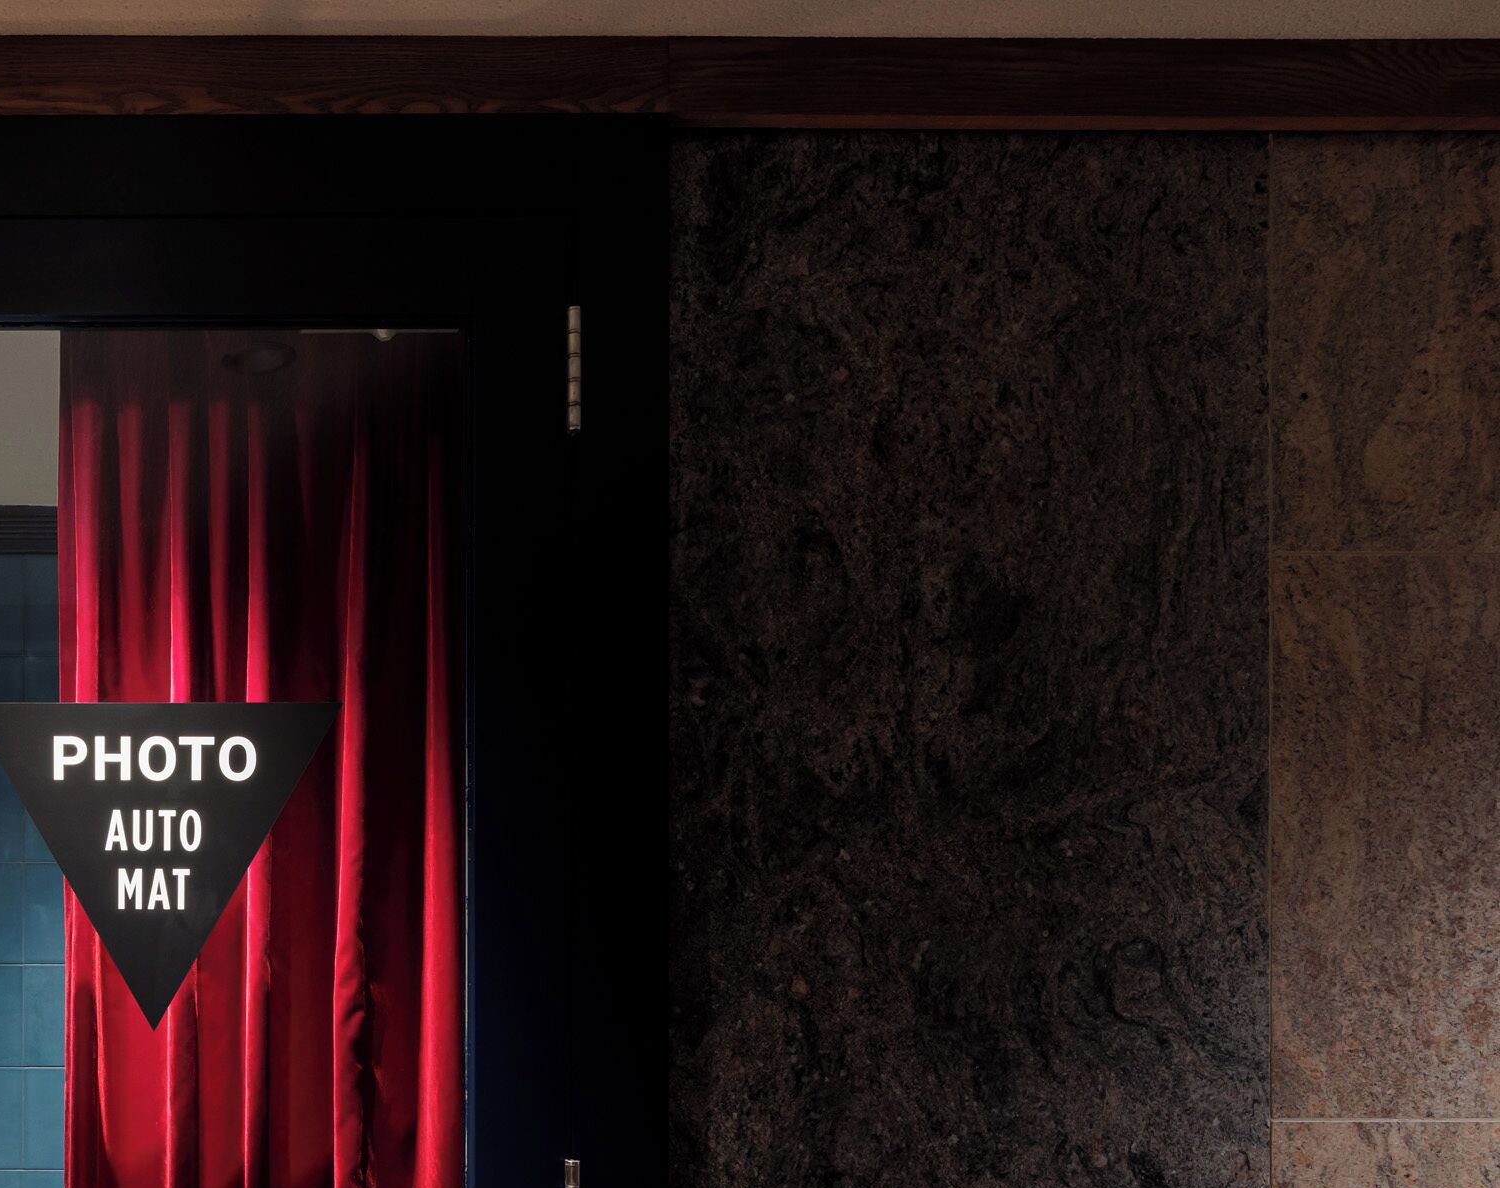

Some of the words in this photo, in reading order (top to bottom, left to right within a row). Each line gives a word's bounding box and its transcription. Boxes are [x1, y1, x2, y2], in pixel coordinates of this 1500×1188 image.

[53, 735, 257, 782] PHOTO
[105, 809, 202, 852] AUTO
[117, 868, 190, 910] MAT
